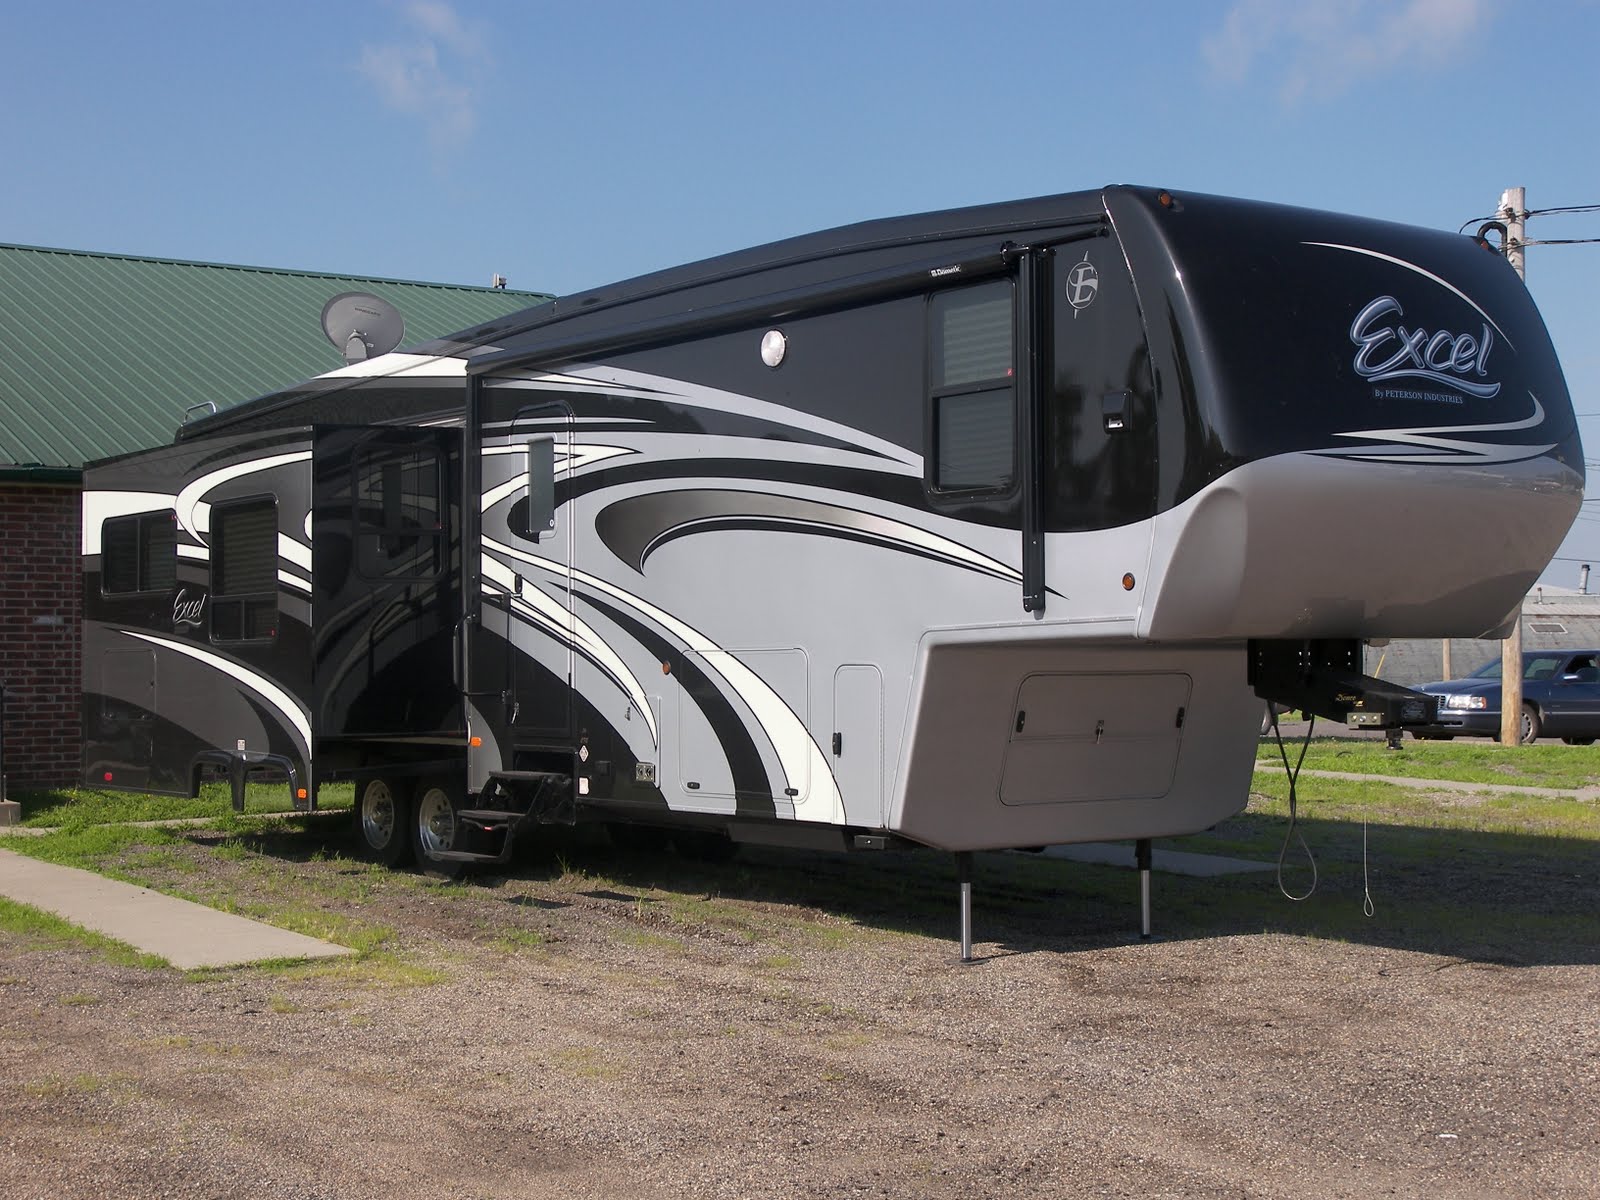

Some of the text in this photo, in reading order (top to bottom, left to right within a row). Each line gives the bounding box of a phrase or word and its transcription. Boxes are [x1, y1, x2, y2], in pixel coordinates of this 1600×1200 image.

[1350, 295, 1494, 376] Excel
[1374, 389, 1463, 404] By PETERSON INDUSTRIES
[172, 588, 207, 622] Excel
